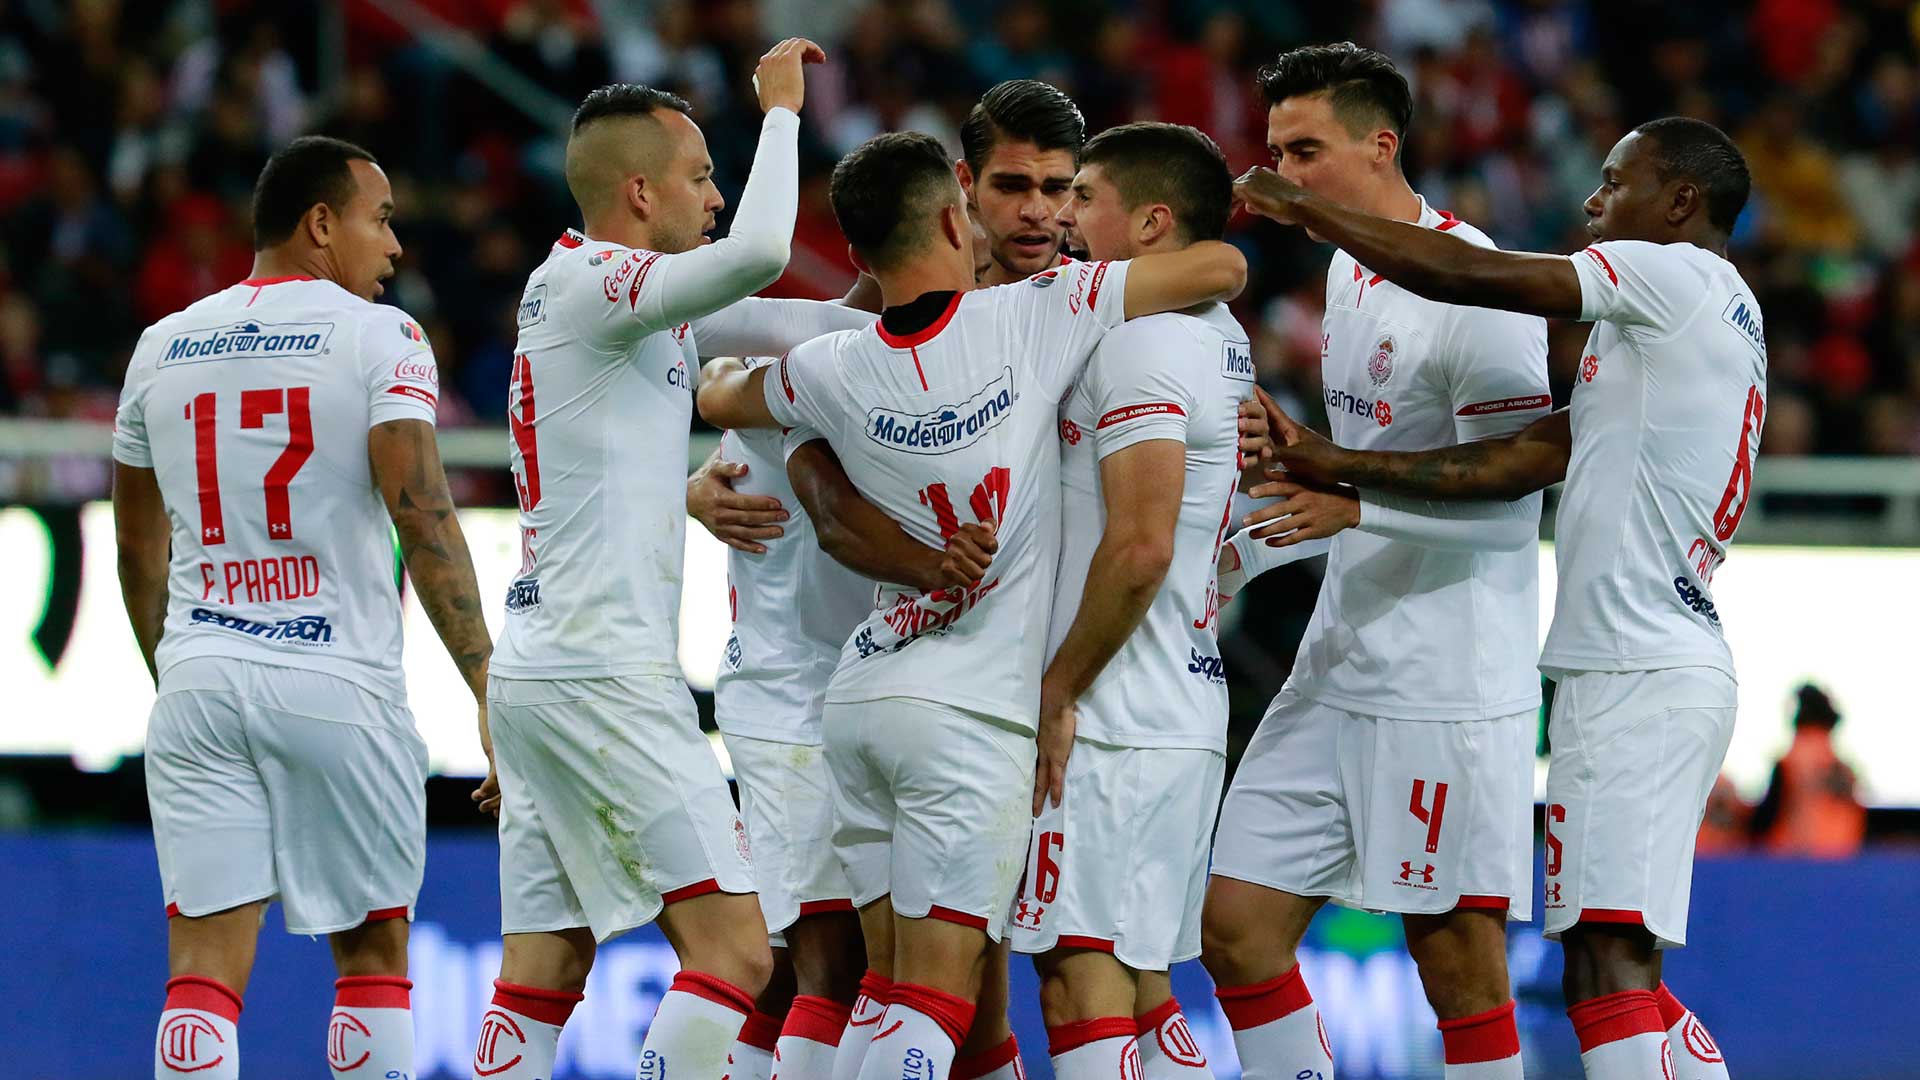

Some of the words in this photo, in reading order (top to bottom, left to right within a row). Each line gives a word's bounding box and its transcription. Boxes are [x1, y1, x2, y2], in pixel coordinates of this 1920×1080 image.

[1103, 411, 1127, 423] UNDER
[1128, 405, 1168, 417] ARMOUR
[1474, 401, 1505, 413] UNDER
[1507, 398, 1543, 409] ARMOUR
[184, 386, 314, 545] 17
[1713, 384, 1765, 542] 6
[200, 555, 320, 605] F.PARDO
[1409, 779, 1448, 854] 4
[1018, 831, 1064, 905] 6
